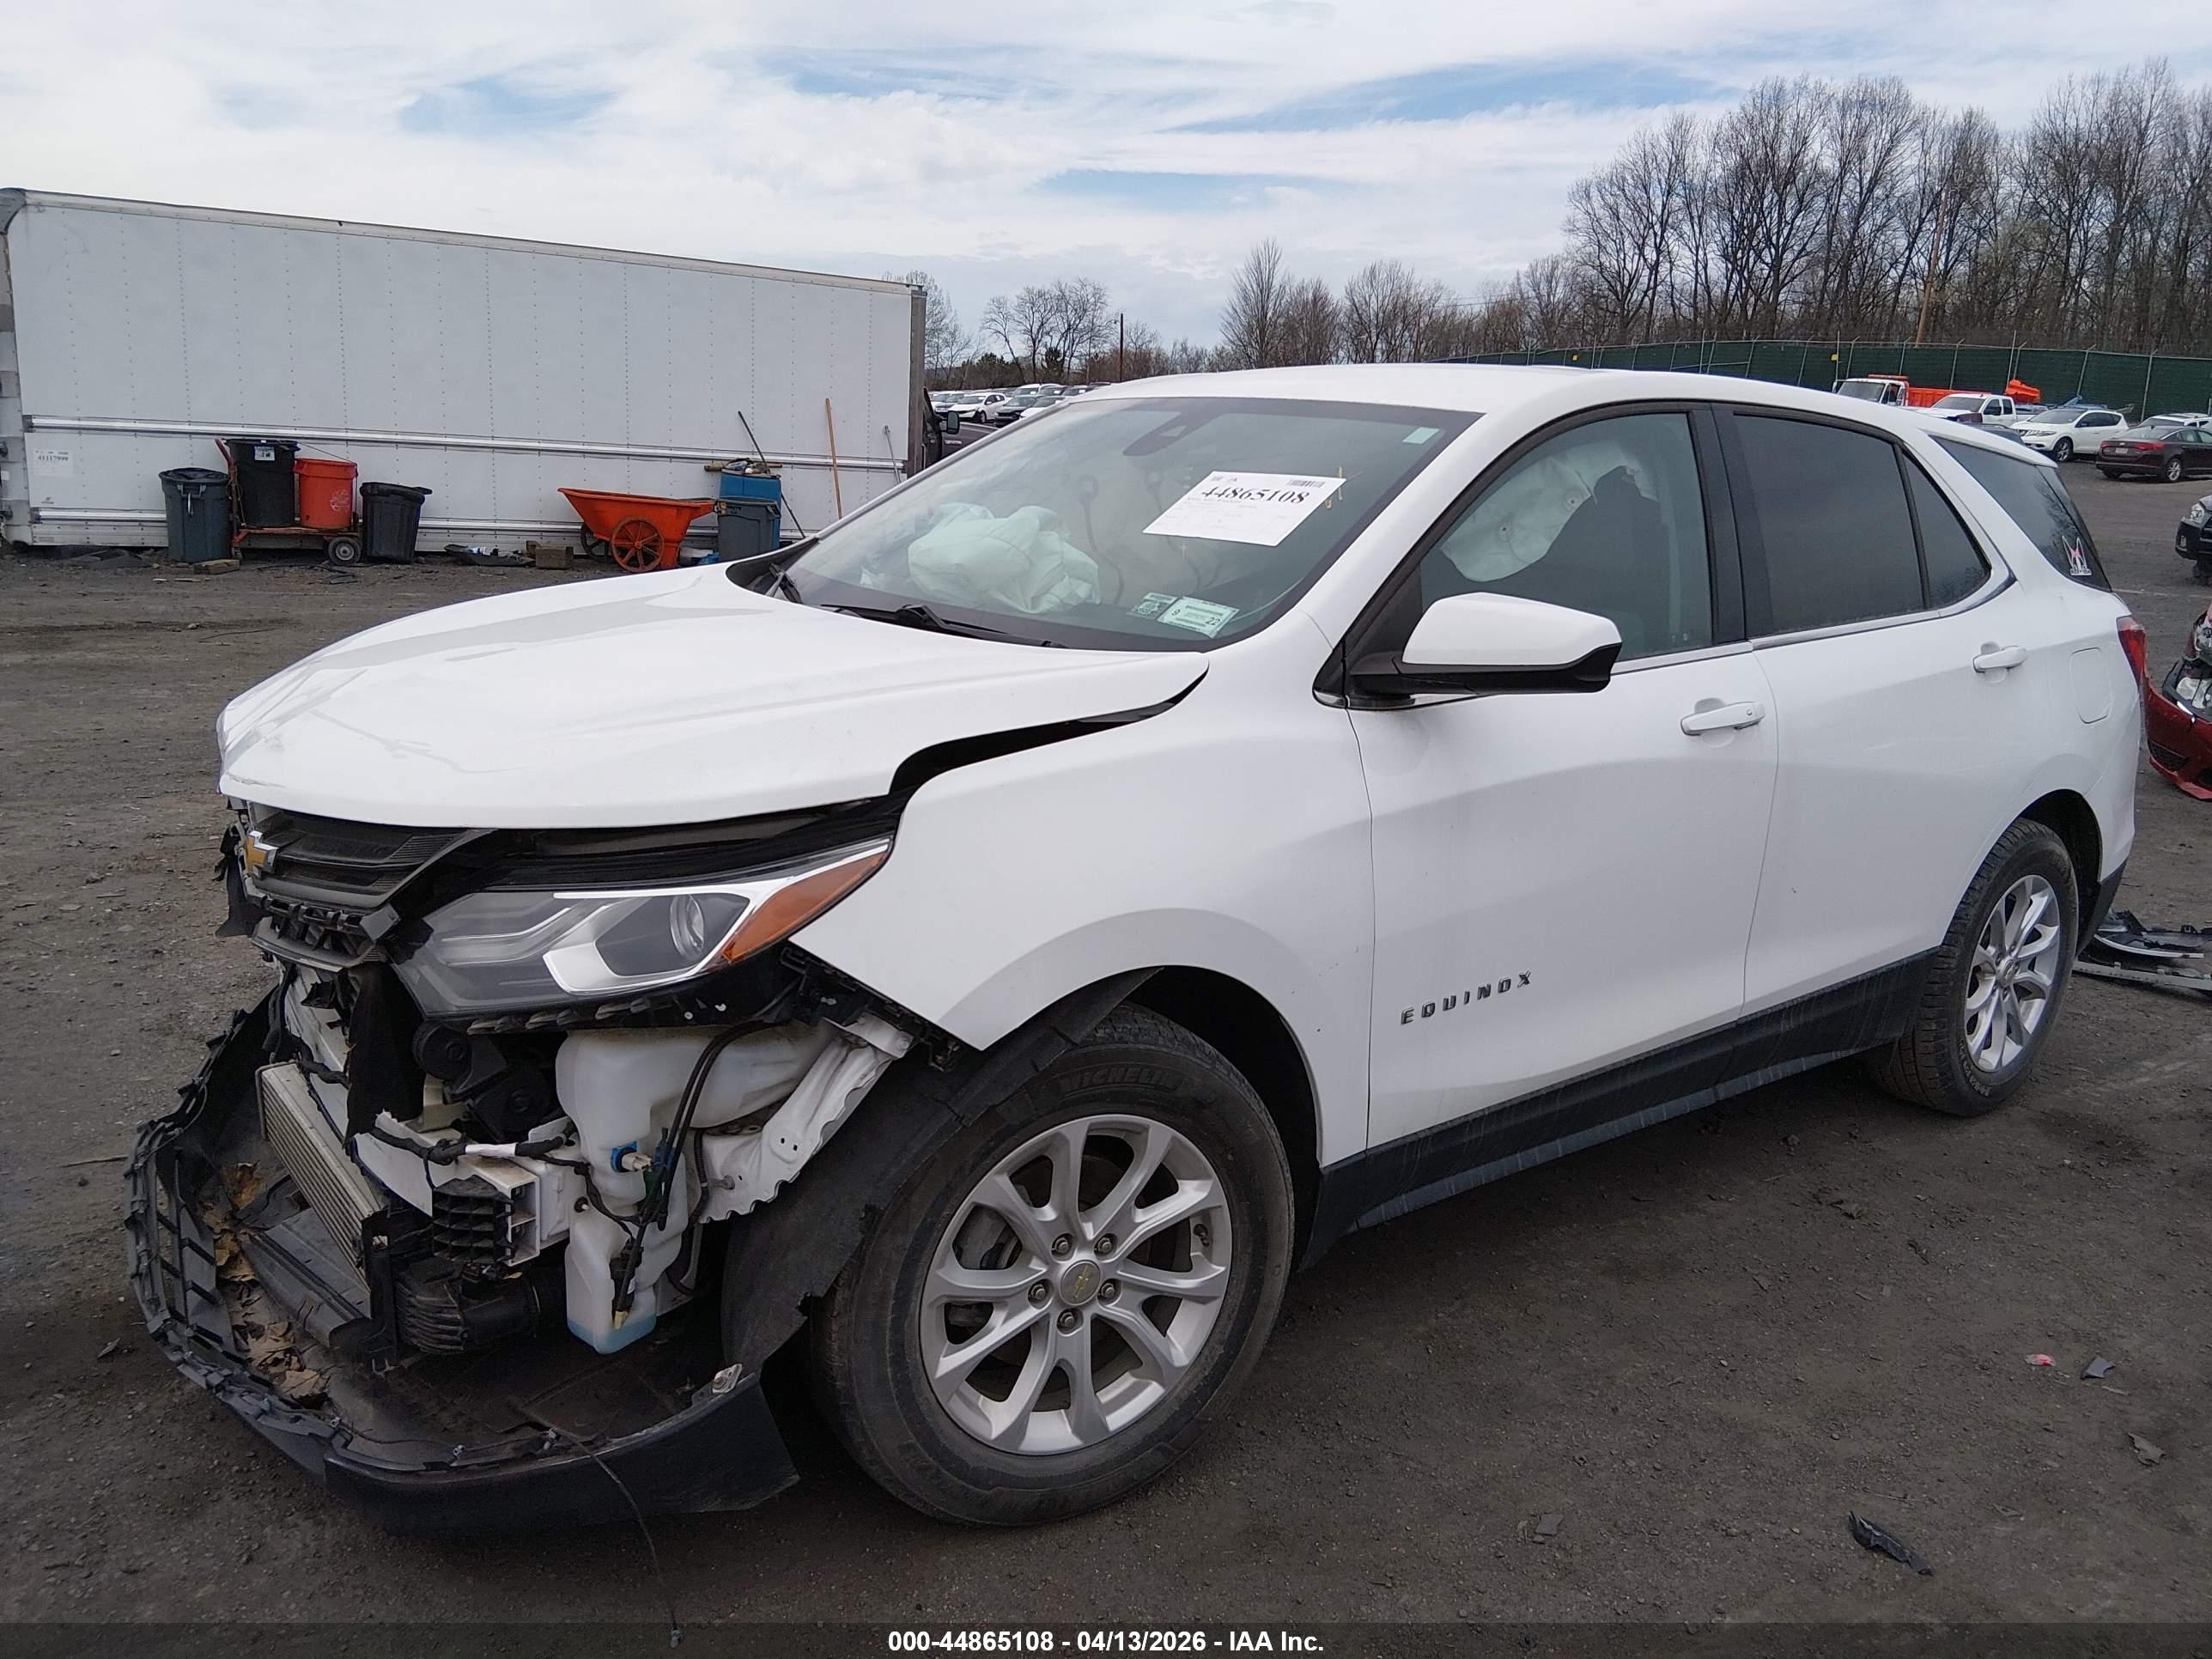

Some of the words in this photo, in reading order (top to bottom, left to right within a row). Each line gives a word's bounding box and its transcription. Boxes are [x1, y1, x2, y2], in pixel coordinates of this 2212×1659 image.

[1201, 486, 1310, 505] 44865108
[1205, 617, 1221, 626] 22
[1401, 969, 1532, 1025] EQUINOX
[1060, 1067, 1179, 1092] MICHELIN
